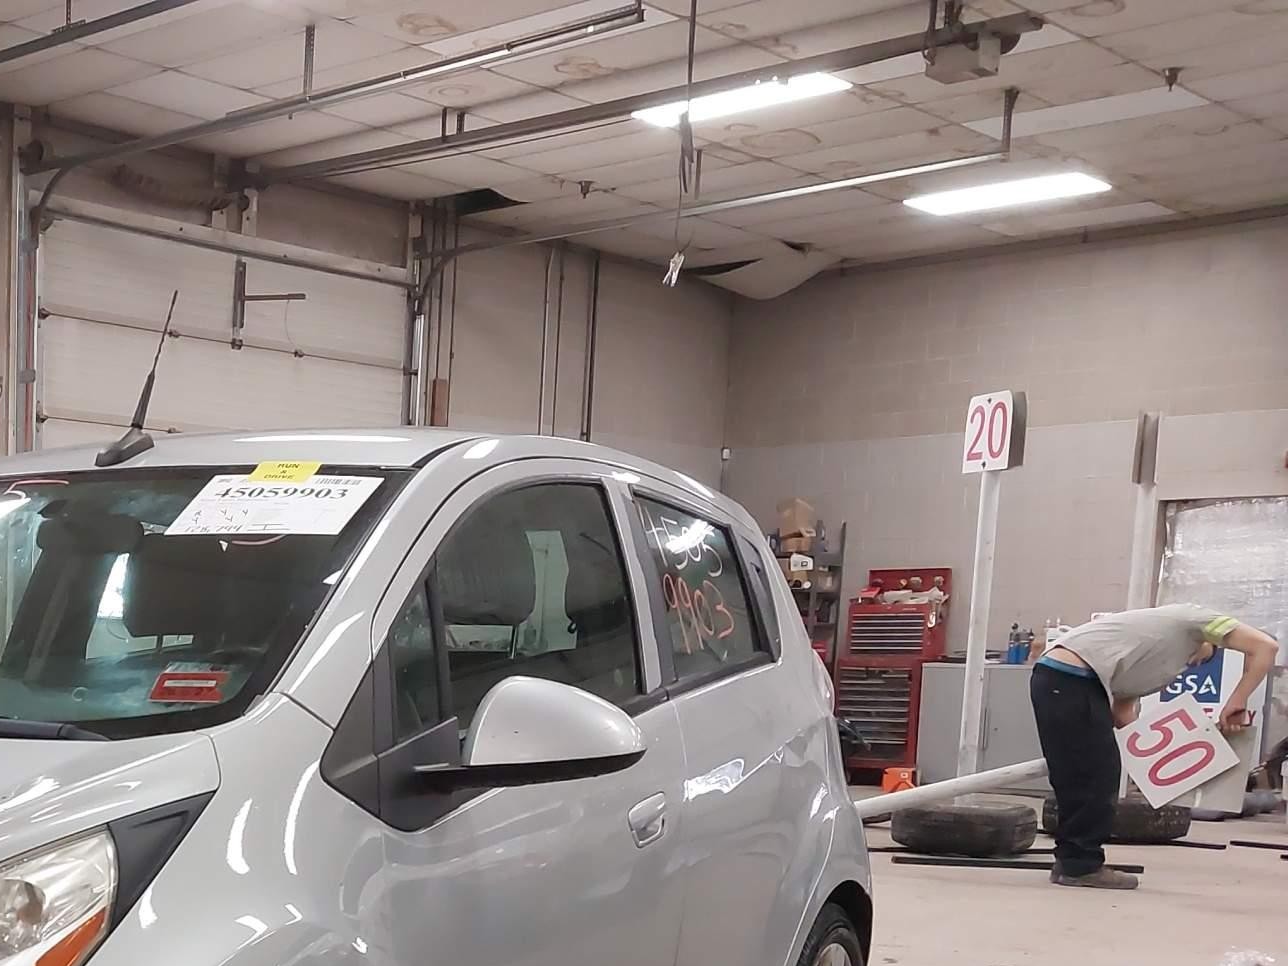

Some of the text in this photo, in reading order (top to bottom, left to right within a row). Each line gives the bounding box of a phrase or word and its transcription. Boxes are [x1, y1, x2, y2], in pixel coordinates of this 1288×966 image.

[966, 401, 1008, 462] 20
[215, 487, 349, 499] 45059903
[663, 573, 734, 655] 9903
[1165, 674, 1217, 695] GSA
[1126, 708, 1215, 786] 50
